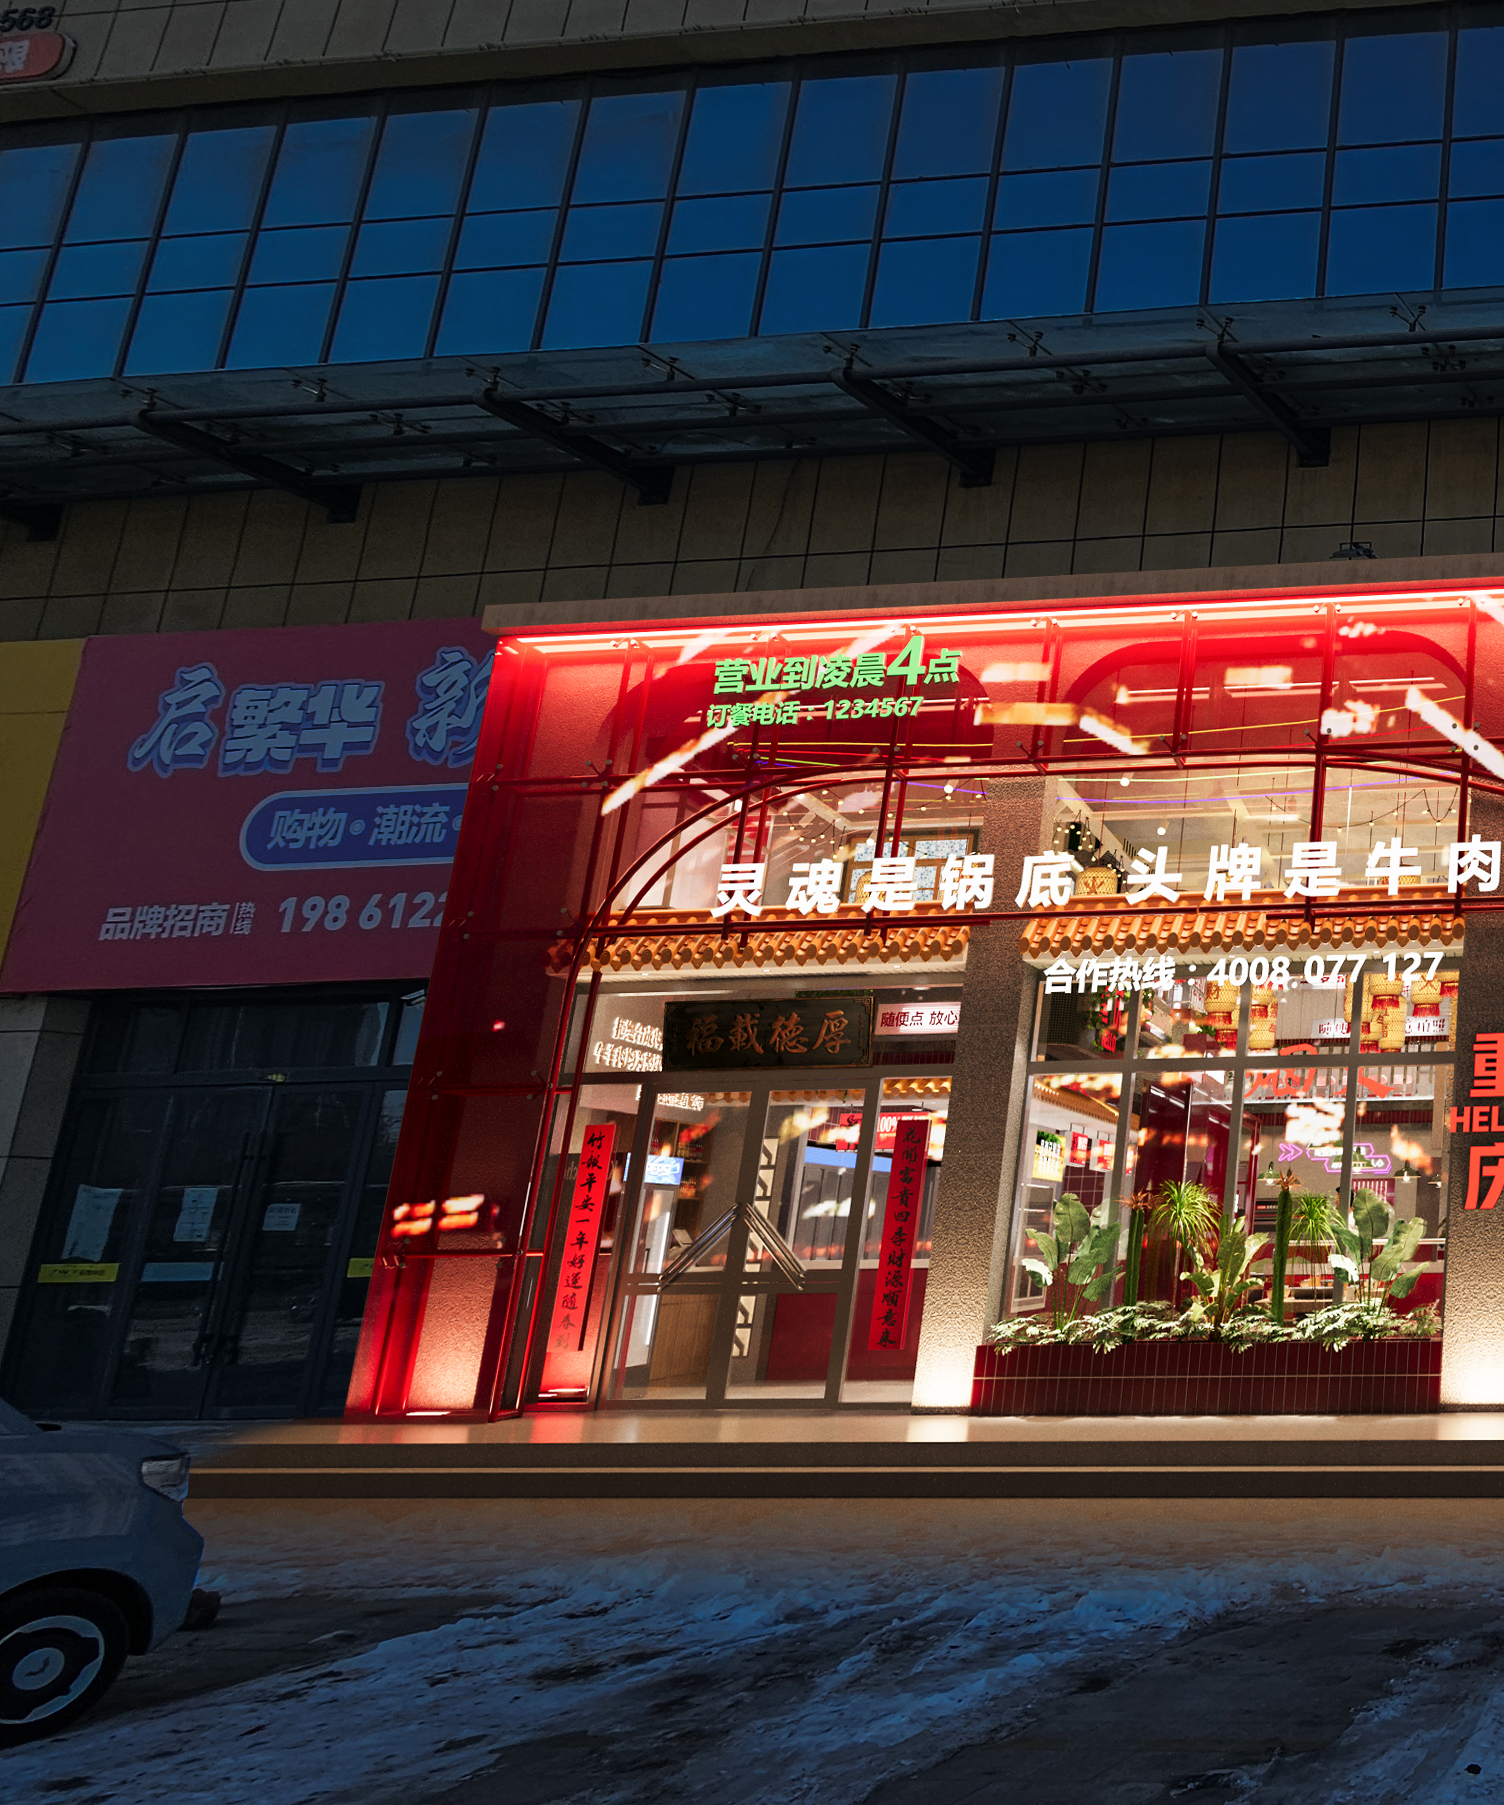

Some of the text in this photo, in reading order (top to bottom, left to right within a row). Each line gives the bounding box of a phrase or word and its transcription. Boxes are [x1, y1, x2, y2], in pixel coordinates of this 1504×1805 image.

[713, 635, 963, 694] 营业到凌晨4点
[710, 834, 1502, 918] 灵魂是锅底 头牌是牛肉
[98, 903, 230, 941] 品牌招商
[278, 896, 349, 933] 198
[880, 1010, 924, 1028] 随便点
